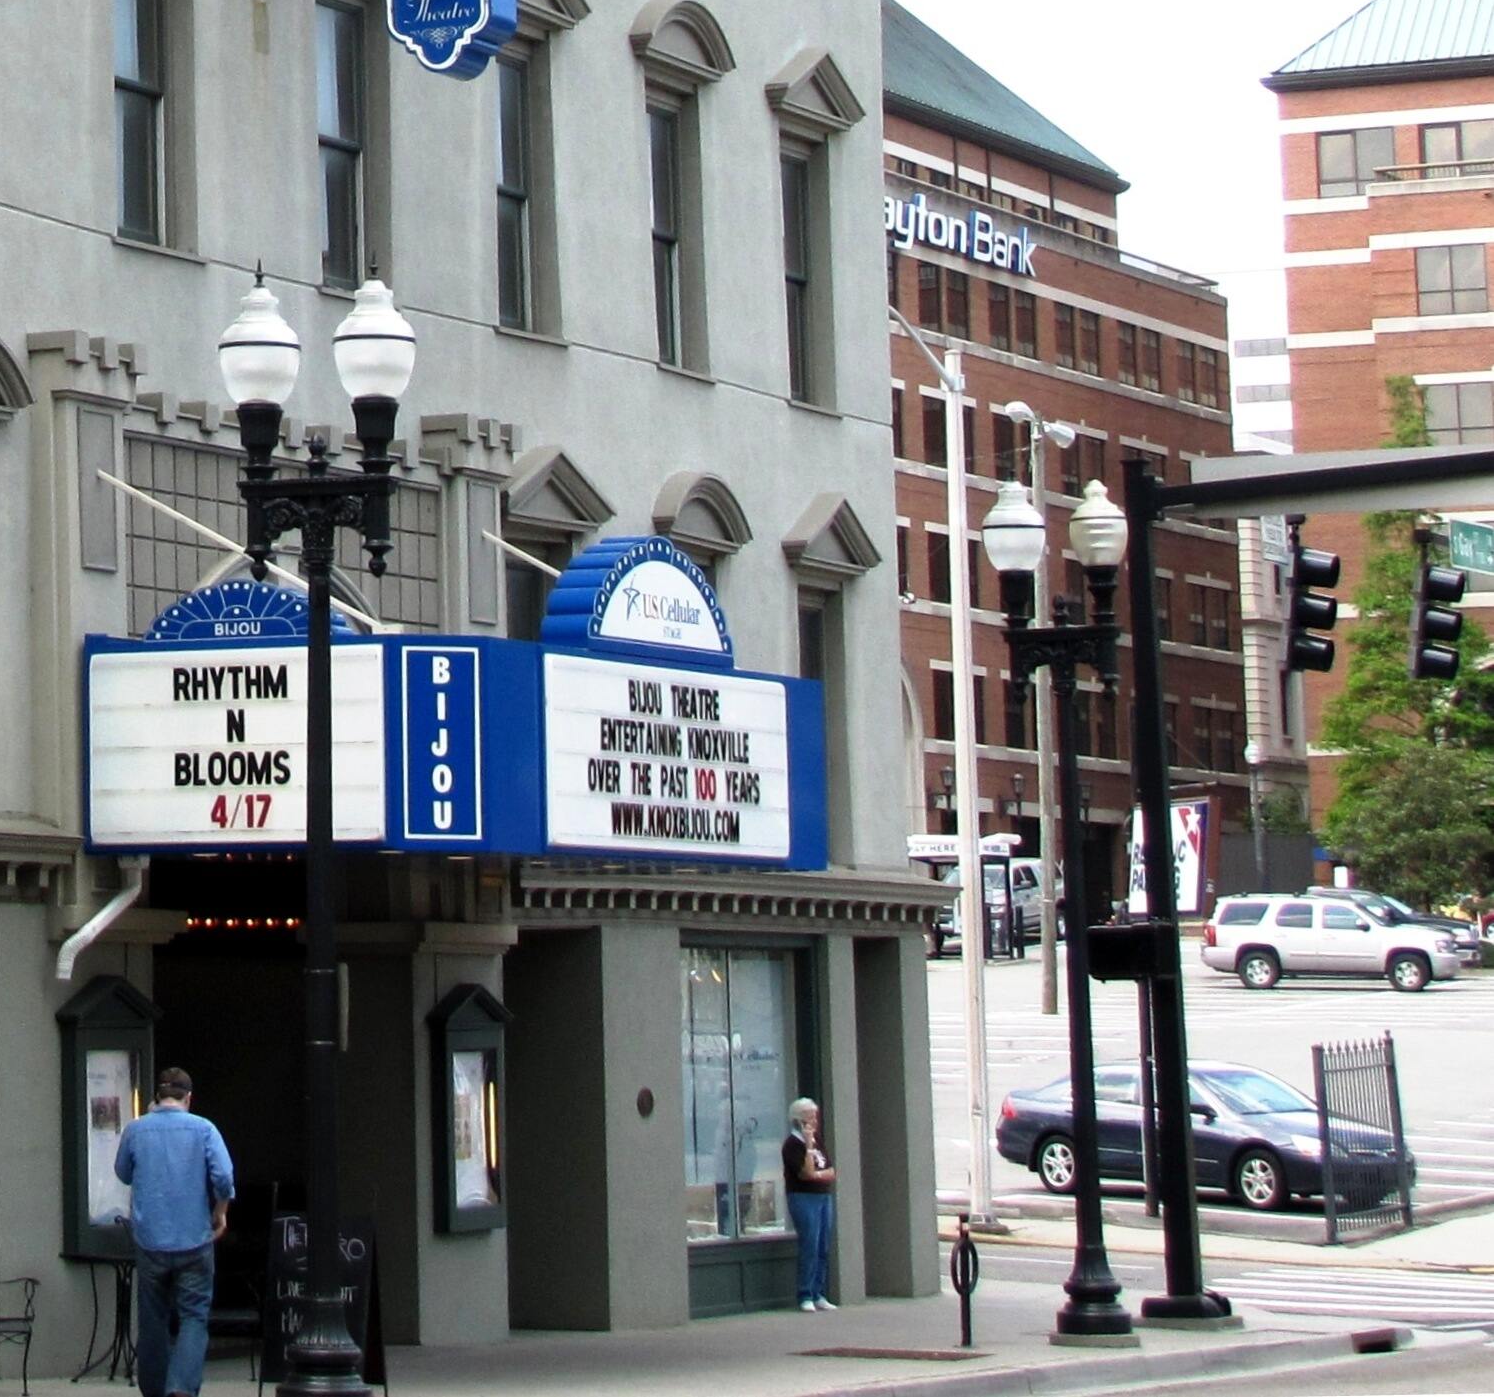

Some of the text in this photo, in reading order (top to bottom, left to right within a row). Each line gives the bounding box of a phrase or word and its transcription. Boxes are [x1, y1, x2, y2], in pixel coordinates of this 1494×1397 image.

[970, 209, 1037, 277] Bank
[660, 595, 700, 625] Cellular
[214, 622, 261, 636] BIJOU
[173, 665, 287, 701] RHYTHM
[628, 679, 720, 721] BIJOU THEATRE
[227, 709, 245, 743] N
[431, 655, 453, 830] BIJOU
[600, 718, 749, 764] ENTERTAINING KNOXVILLE
[174, 751, 291, 786] BLOOMS
[588, 758, 760, 806] OVER THE PAST 100 YEARS
[211, 794, 272, 828] 4/17
[611, 802, 740, 843] WWW.KNOXBIJOU.COM
[930, 844, 956, 852] HERE
